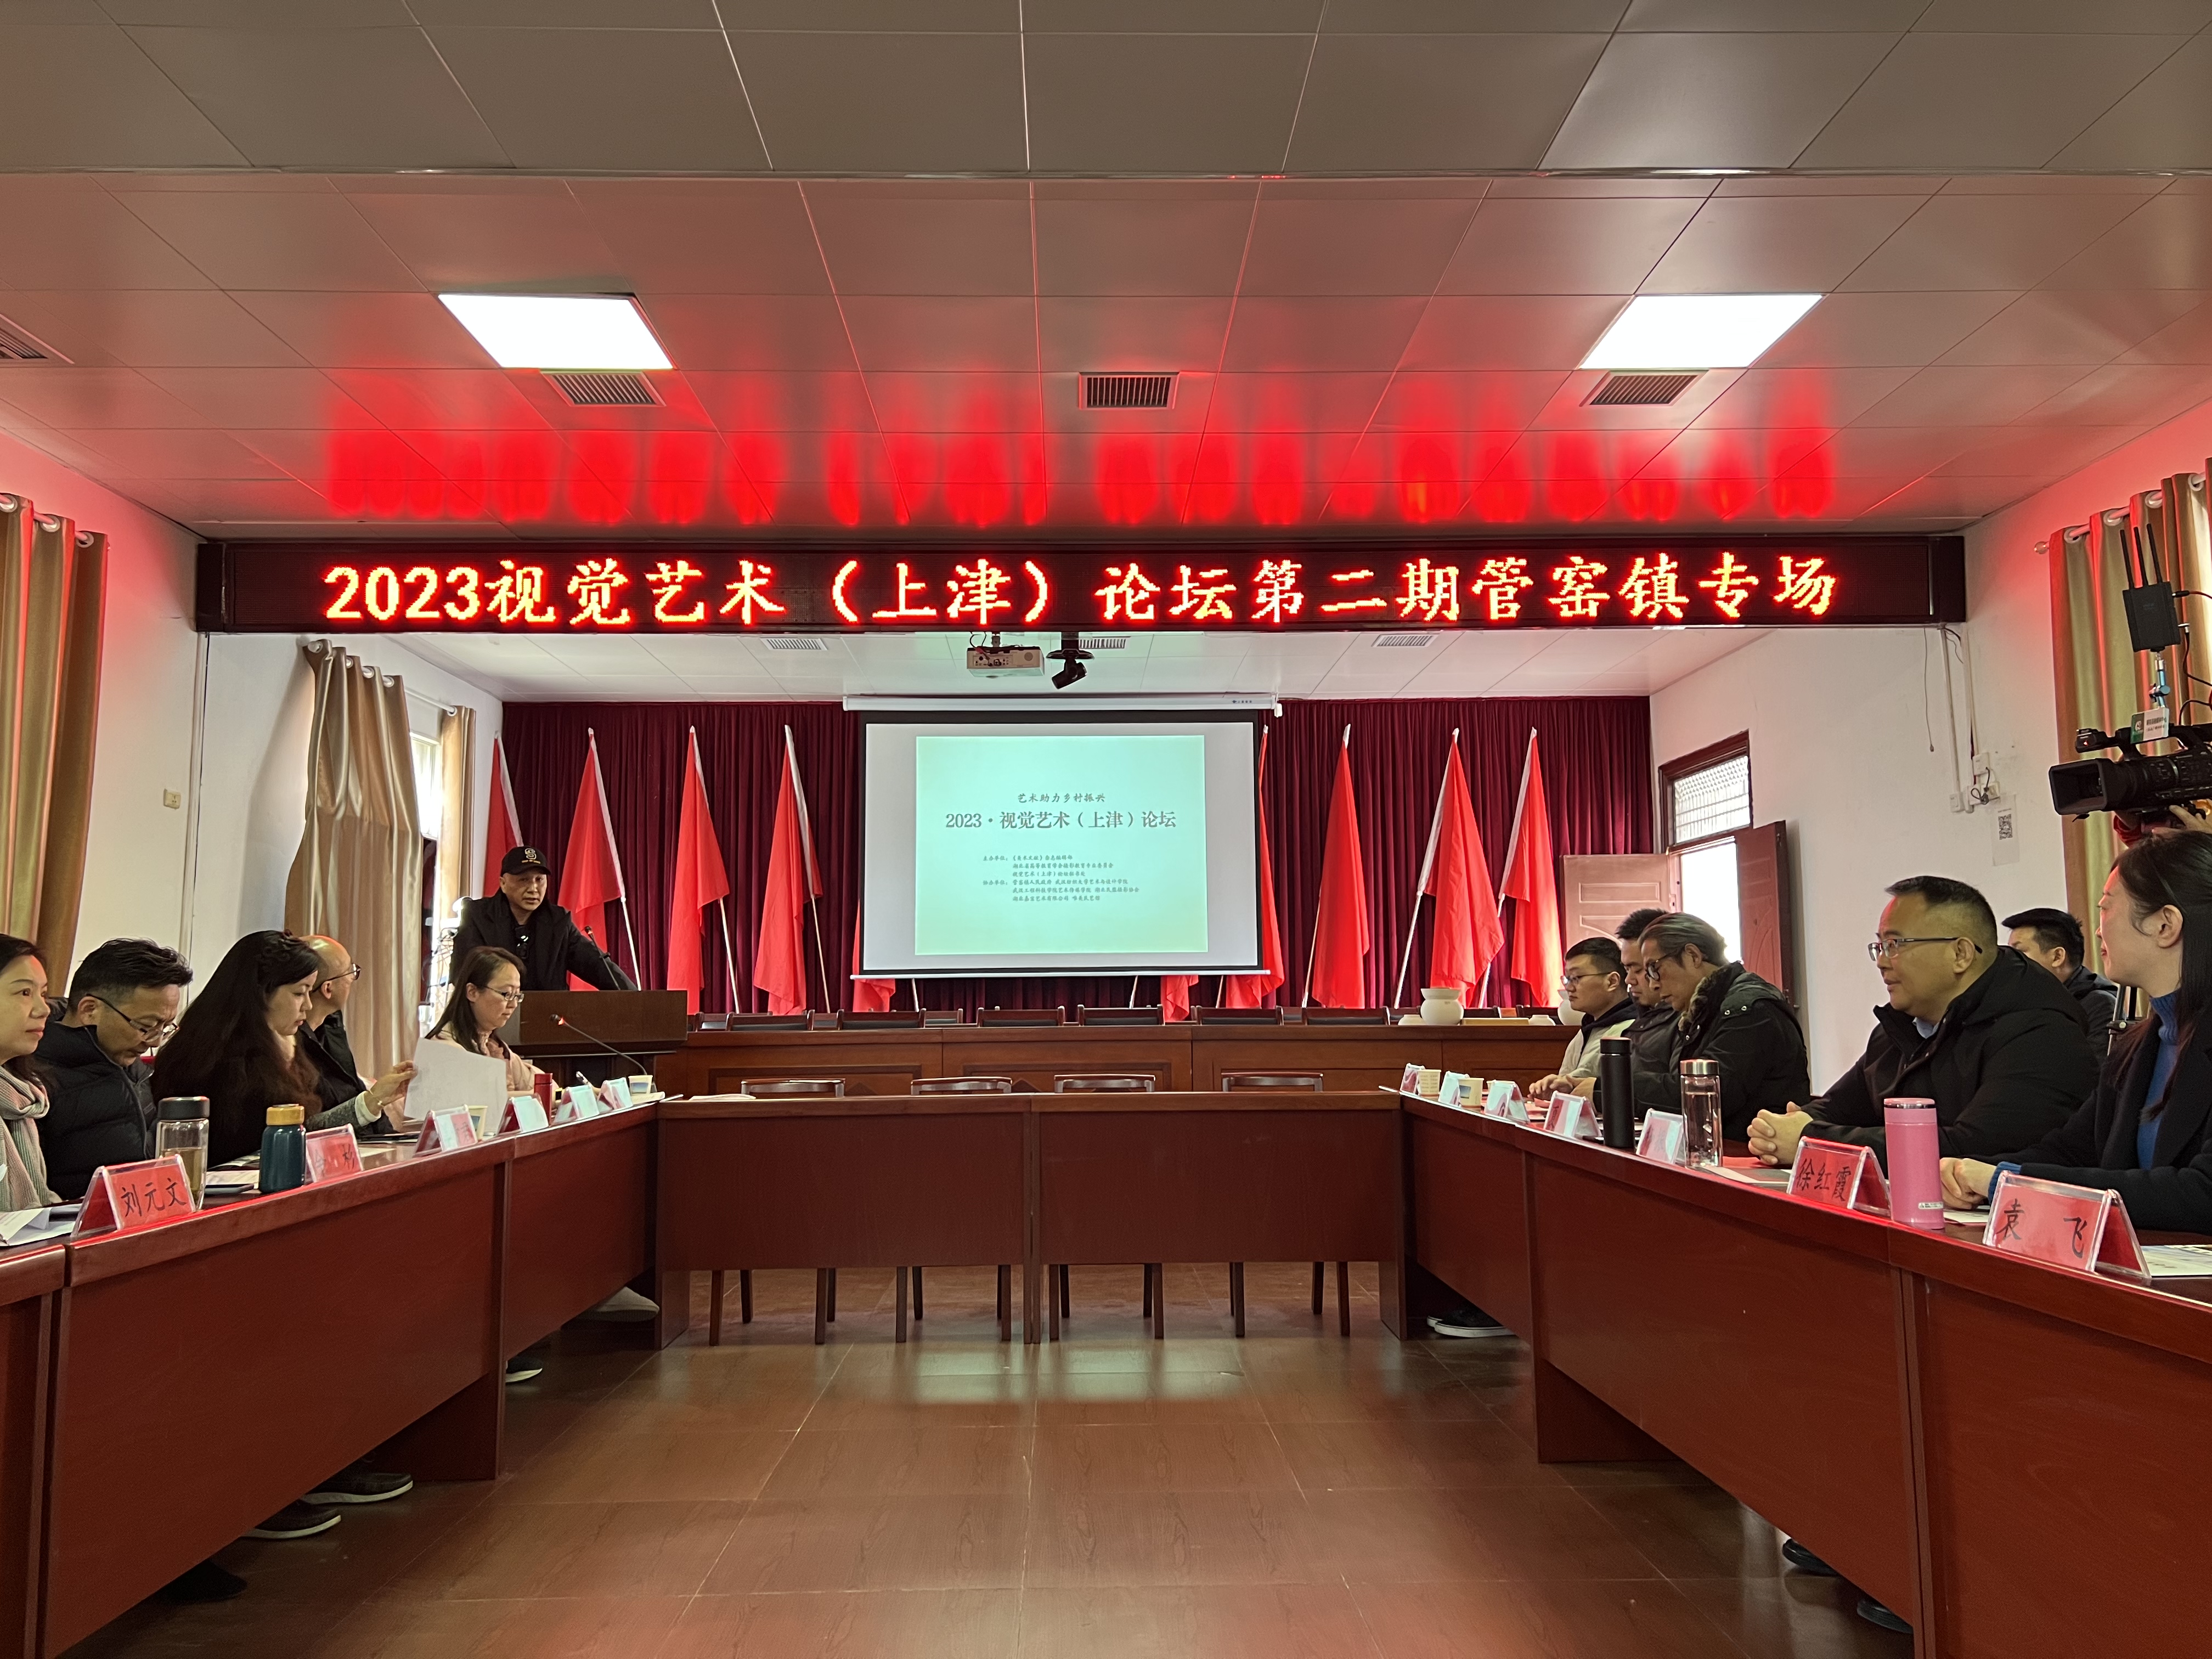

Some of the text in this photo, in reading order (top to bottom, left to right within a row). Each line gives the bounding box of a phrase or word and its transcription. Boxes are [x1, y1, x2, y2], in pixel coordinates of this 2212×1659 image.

[1018, 793, 1105, 803] 艺术助力乡村振兴
[121, 1177, 187, 1217] 刘元文
[1796, 1158, 1851, 1201] 徐红霞
